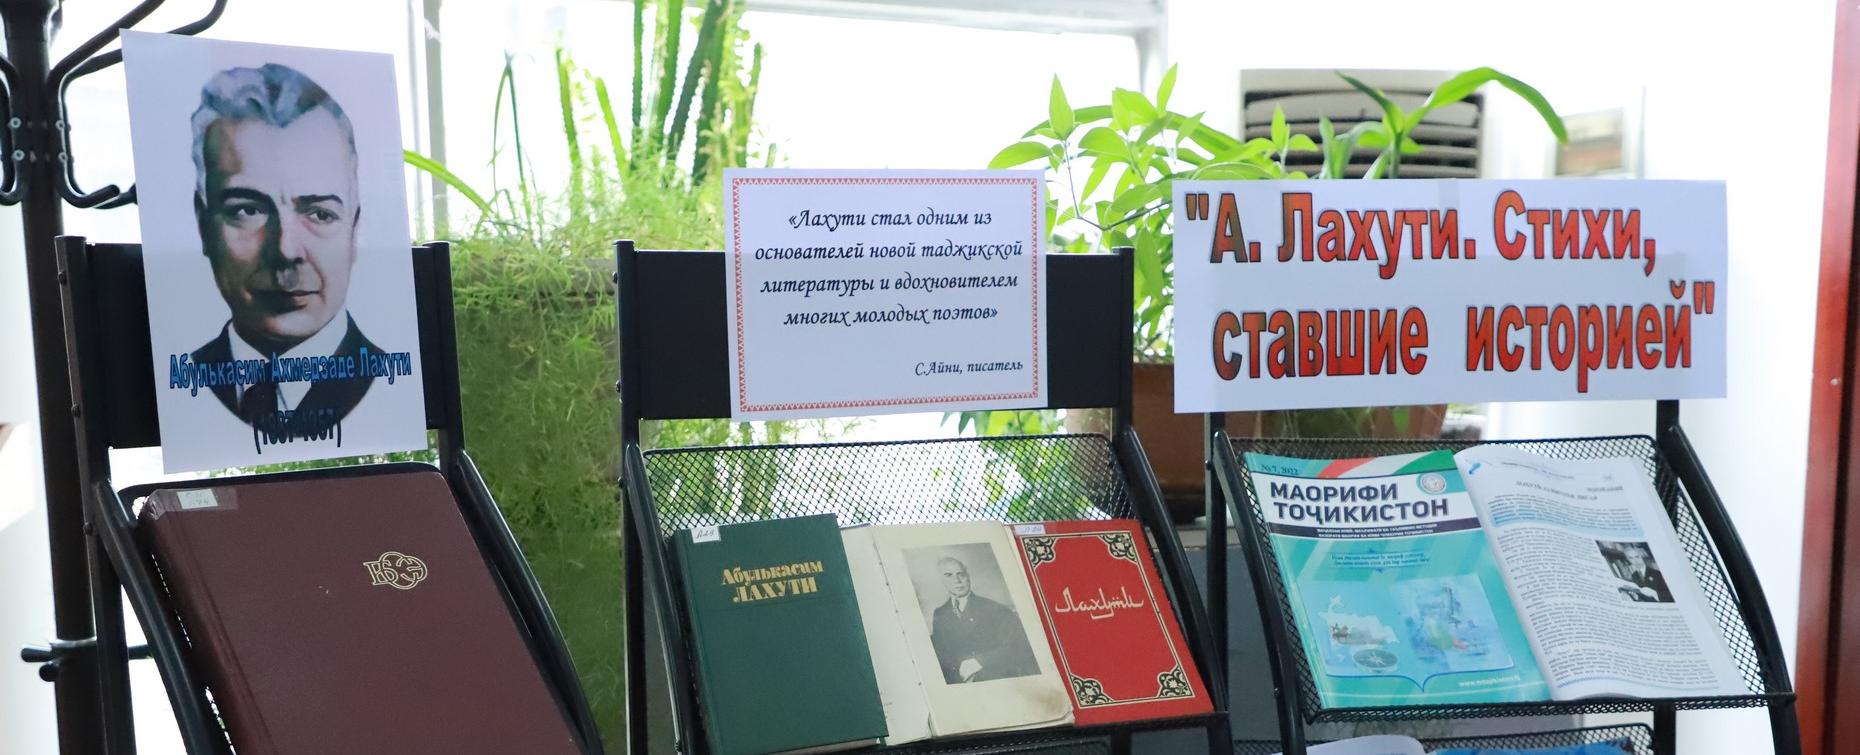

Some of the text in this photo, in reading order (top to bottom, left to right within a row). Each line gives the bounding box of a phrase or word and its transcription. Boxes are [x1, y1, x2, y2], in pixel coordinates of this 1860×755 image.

[788, 206, 992, 232] «Лахути стал одним из
[1185, 189, 1656, 280] "А. Лахути. Стихи,
[755, 238, 1023, 261] основателей новой таджикской
[760, 271, 1018, 298] литературы и вдохновителем
[783, 303, 998, 327] многих молодых поэтов»
[1212, 279, 1715, 393] ставшие историей"
[169, 347, 412, 397] Абулькасим Ахмедзаде Лахути
[915, 360, 1023, 376] С.Айни, писатель
[1270, 481, 1398, 502] МАОРИФИ
[1273, 498, 1449, 525] ТОҶИКИСТОН
[722, 560, 825, 586] Абулькасим
[732, 576, 818, 603] ЛАХУТИ
